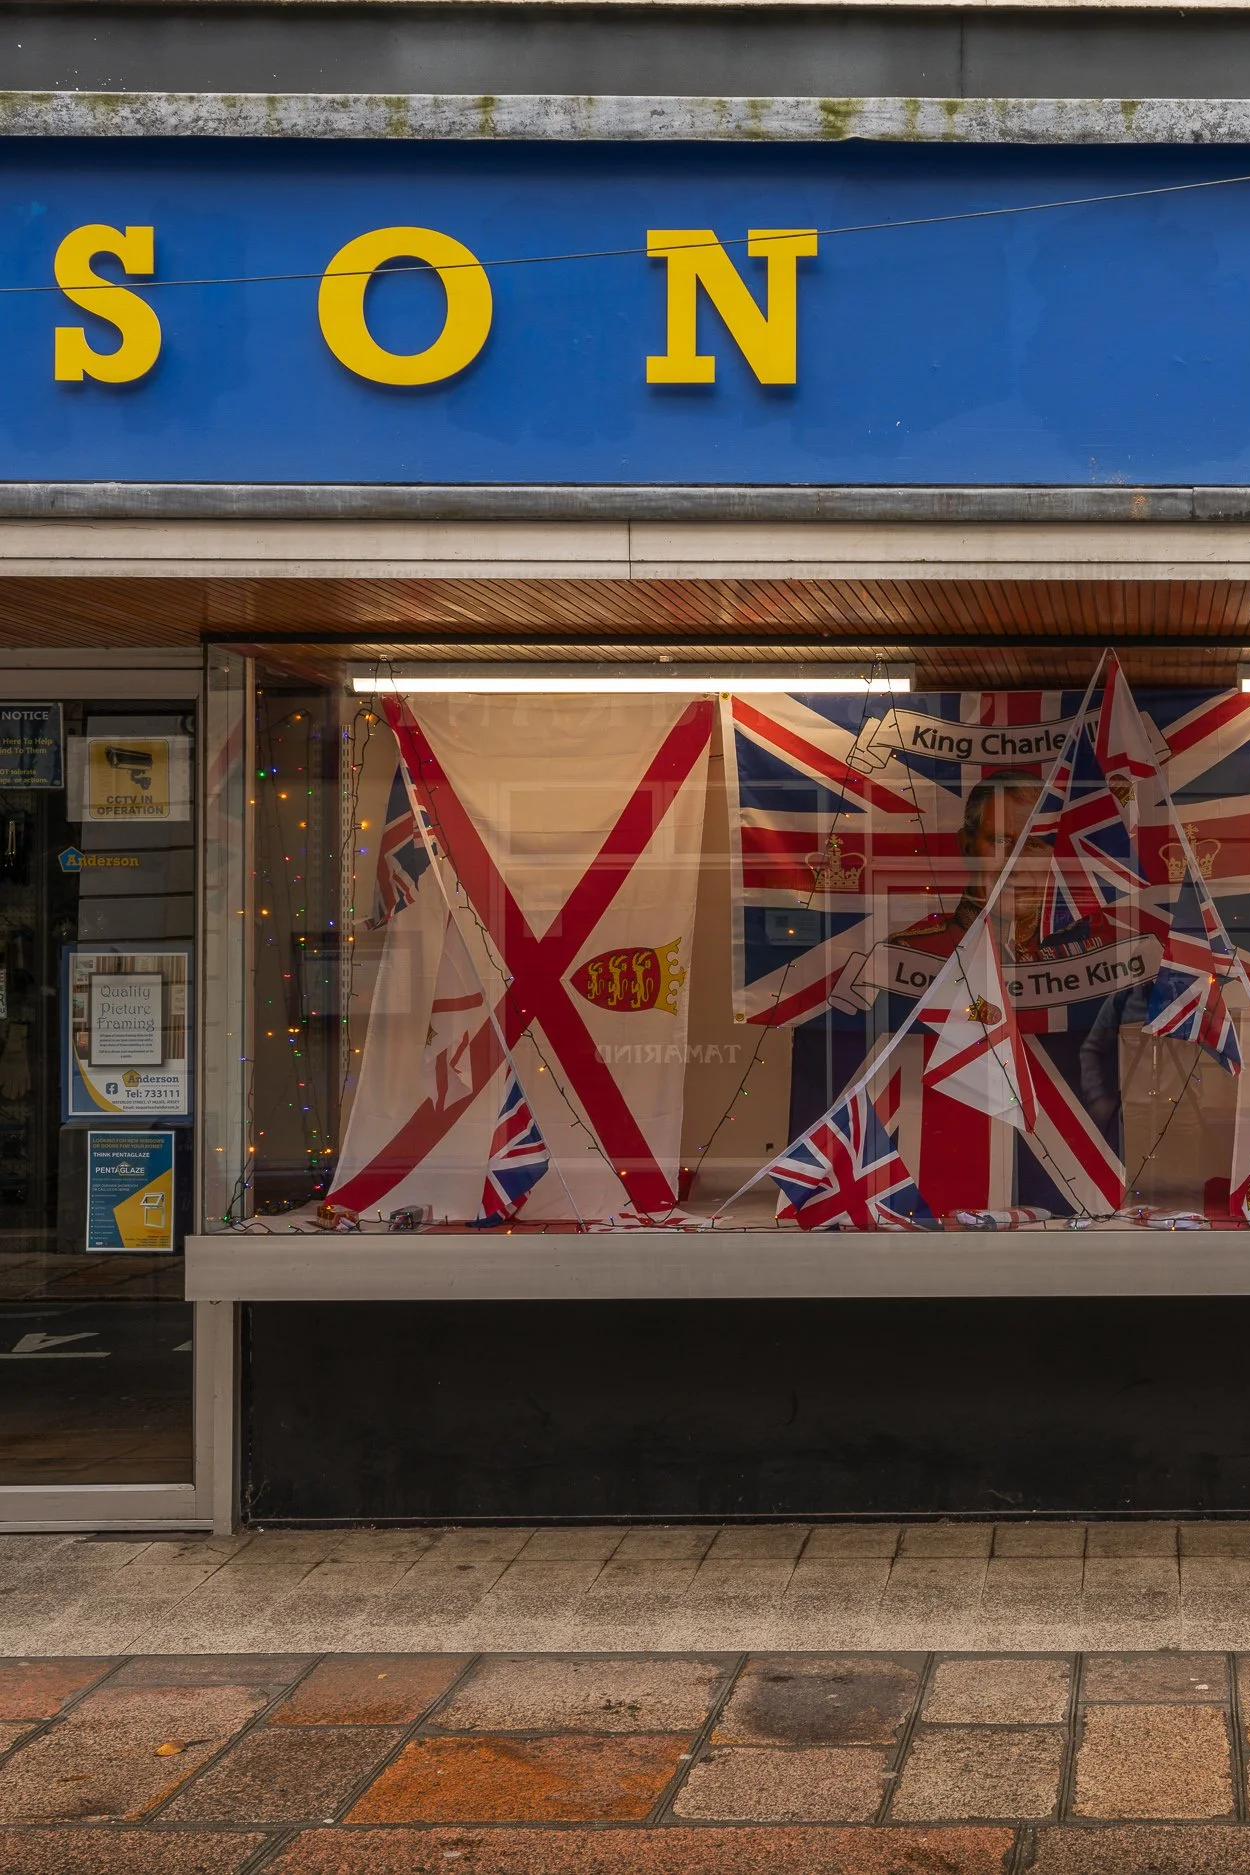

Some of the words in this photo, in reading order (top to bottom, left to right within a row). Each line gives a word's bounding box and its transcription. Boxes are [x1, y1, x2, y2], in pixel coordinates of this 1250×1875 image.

[2, 711, 49, 720] NOTICE
[35, 738, 53, 746] Help
[912, 725, 973, 759] King
[981, 730, 1068, 755] Charle
[106, 795, 137, 805] CCTV
[141, 795, 153, 804] IN
[97, 806, 164, 815] OPERATION
[67, 854, 140, 866] Anderson
[1028, 971, 1080, 997] The
[1085, 955, 1147, 986] King
[100, 985, 151, 1000] Quality
[101, 1002, 151, 1016] Picture
[97, 1017, 155, 1032] Framing
[128, 1074, 179, 1083] Anderson
[125, 1090, 142, 1098] Tel:
[144, 1090, 180, 1098] 733111
